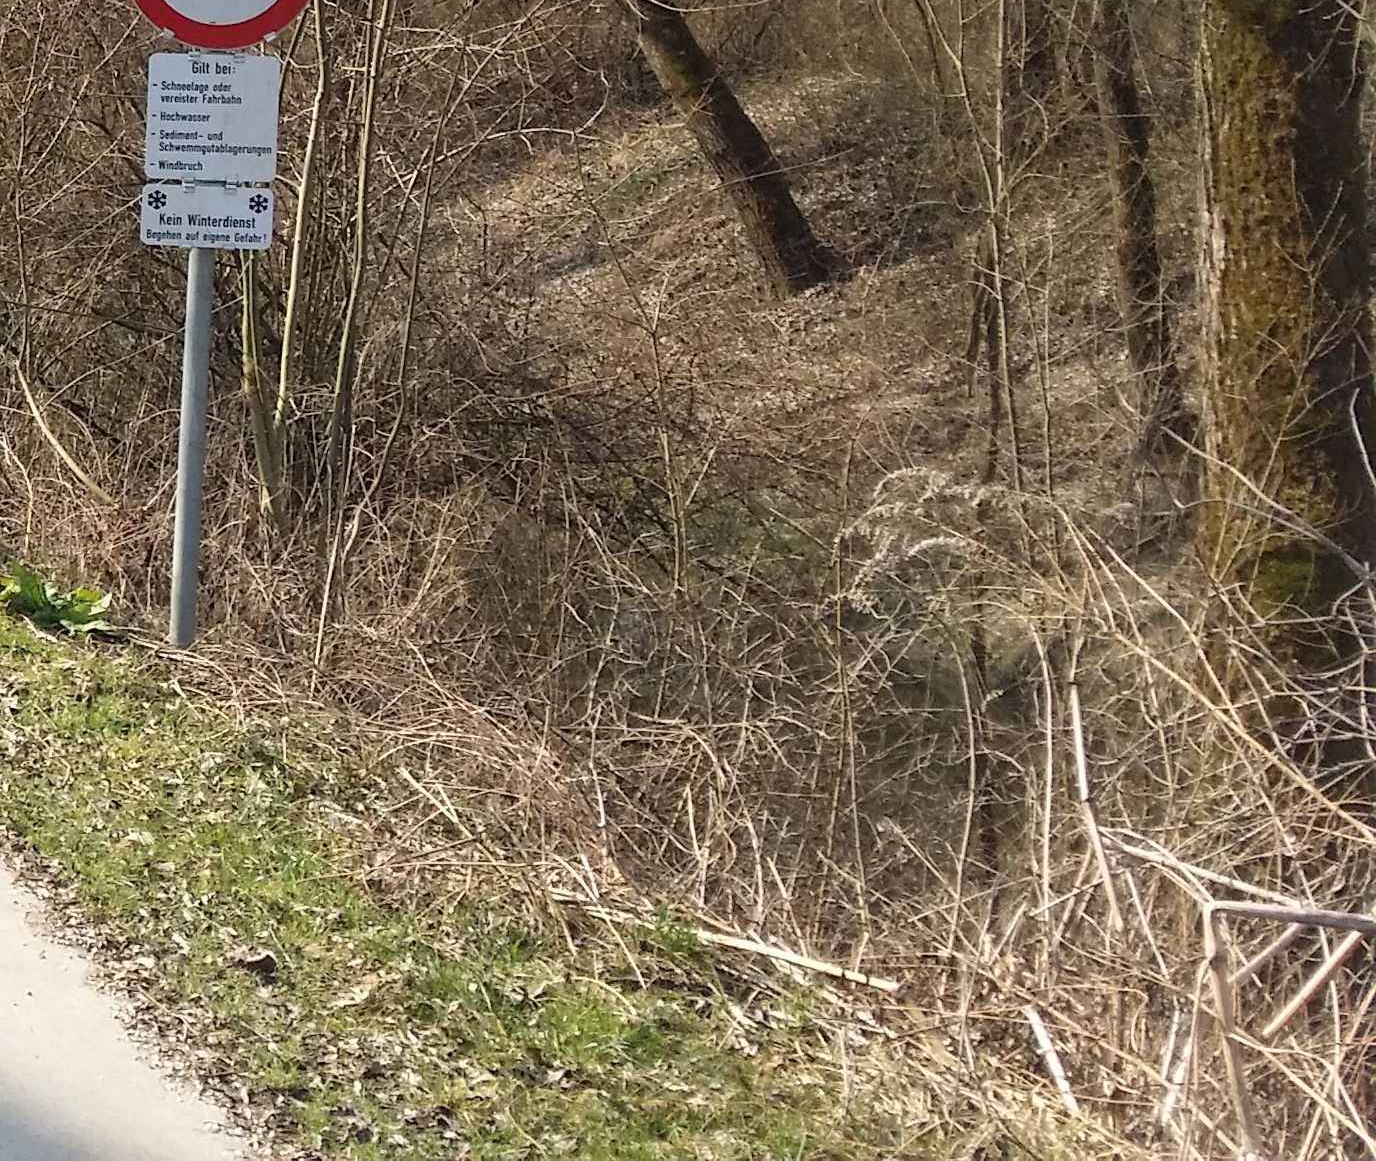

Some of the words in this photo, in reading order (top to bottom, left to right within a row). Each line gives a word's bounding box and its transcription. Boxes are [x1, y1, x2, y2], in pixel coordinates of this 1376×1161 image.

[191, 62, 210, 74] Gilt
[215, 62, 236, 75] bei:
[160, 80, 209, 93] Schneelage
[213, 82, 232, 92] oder
[160, 94, 198, 104] vereister
[202, 94, 242, 104] Fahrbahn
[160, 111, 211, 122] Hochwasser
[159, 129, 203, 140] Sediment-
[207, 131, 223, 141] und
[159, 142, 272, 156] Schwemmgutablagerungen
[158, 160, 203, 170] Windbruch
[159, 213, 182, 226] Kein
[188, 214, 256, 229] Winterdienst
[146, 229, 182, 241] Begehen
[185, 231, 199, 241] auf
[203, 233, 230, 243] eigene
[234, 232, 267, 244] Gefahr!
